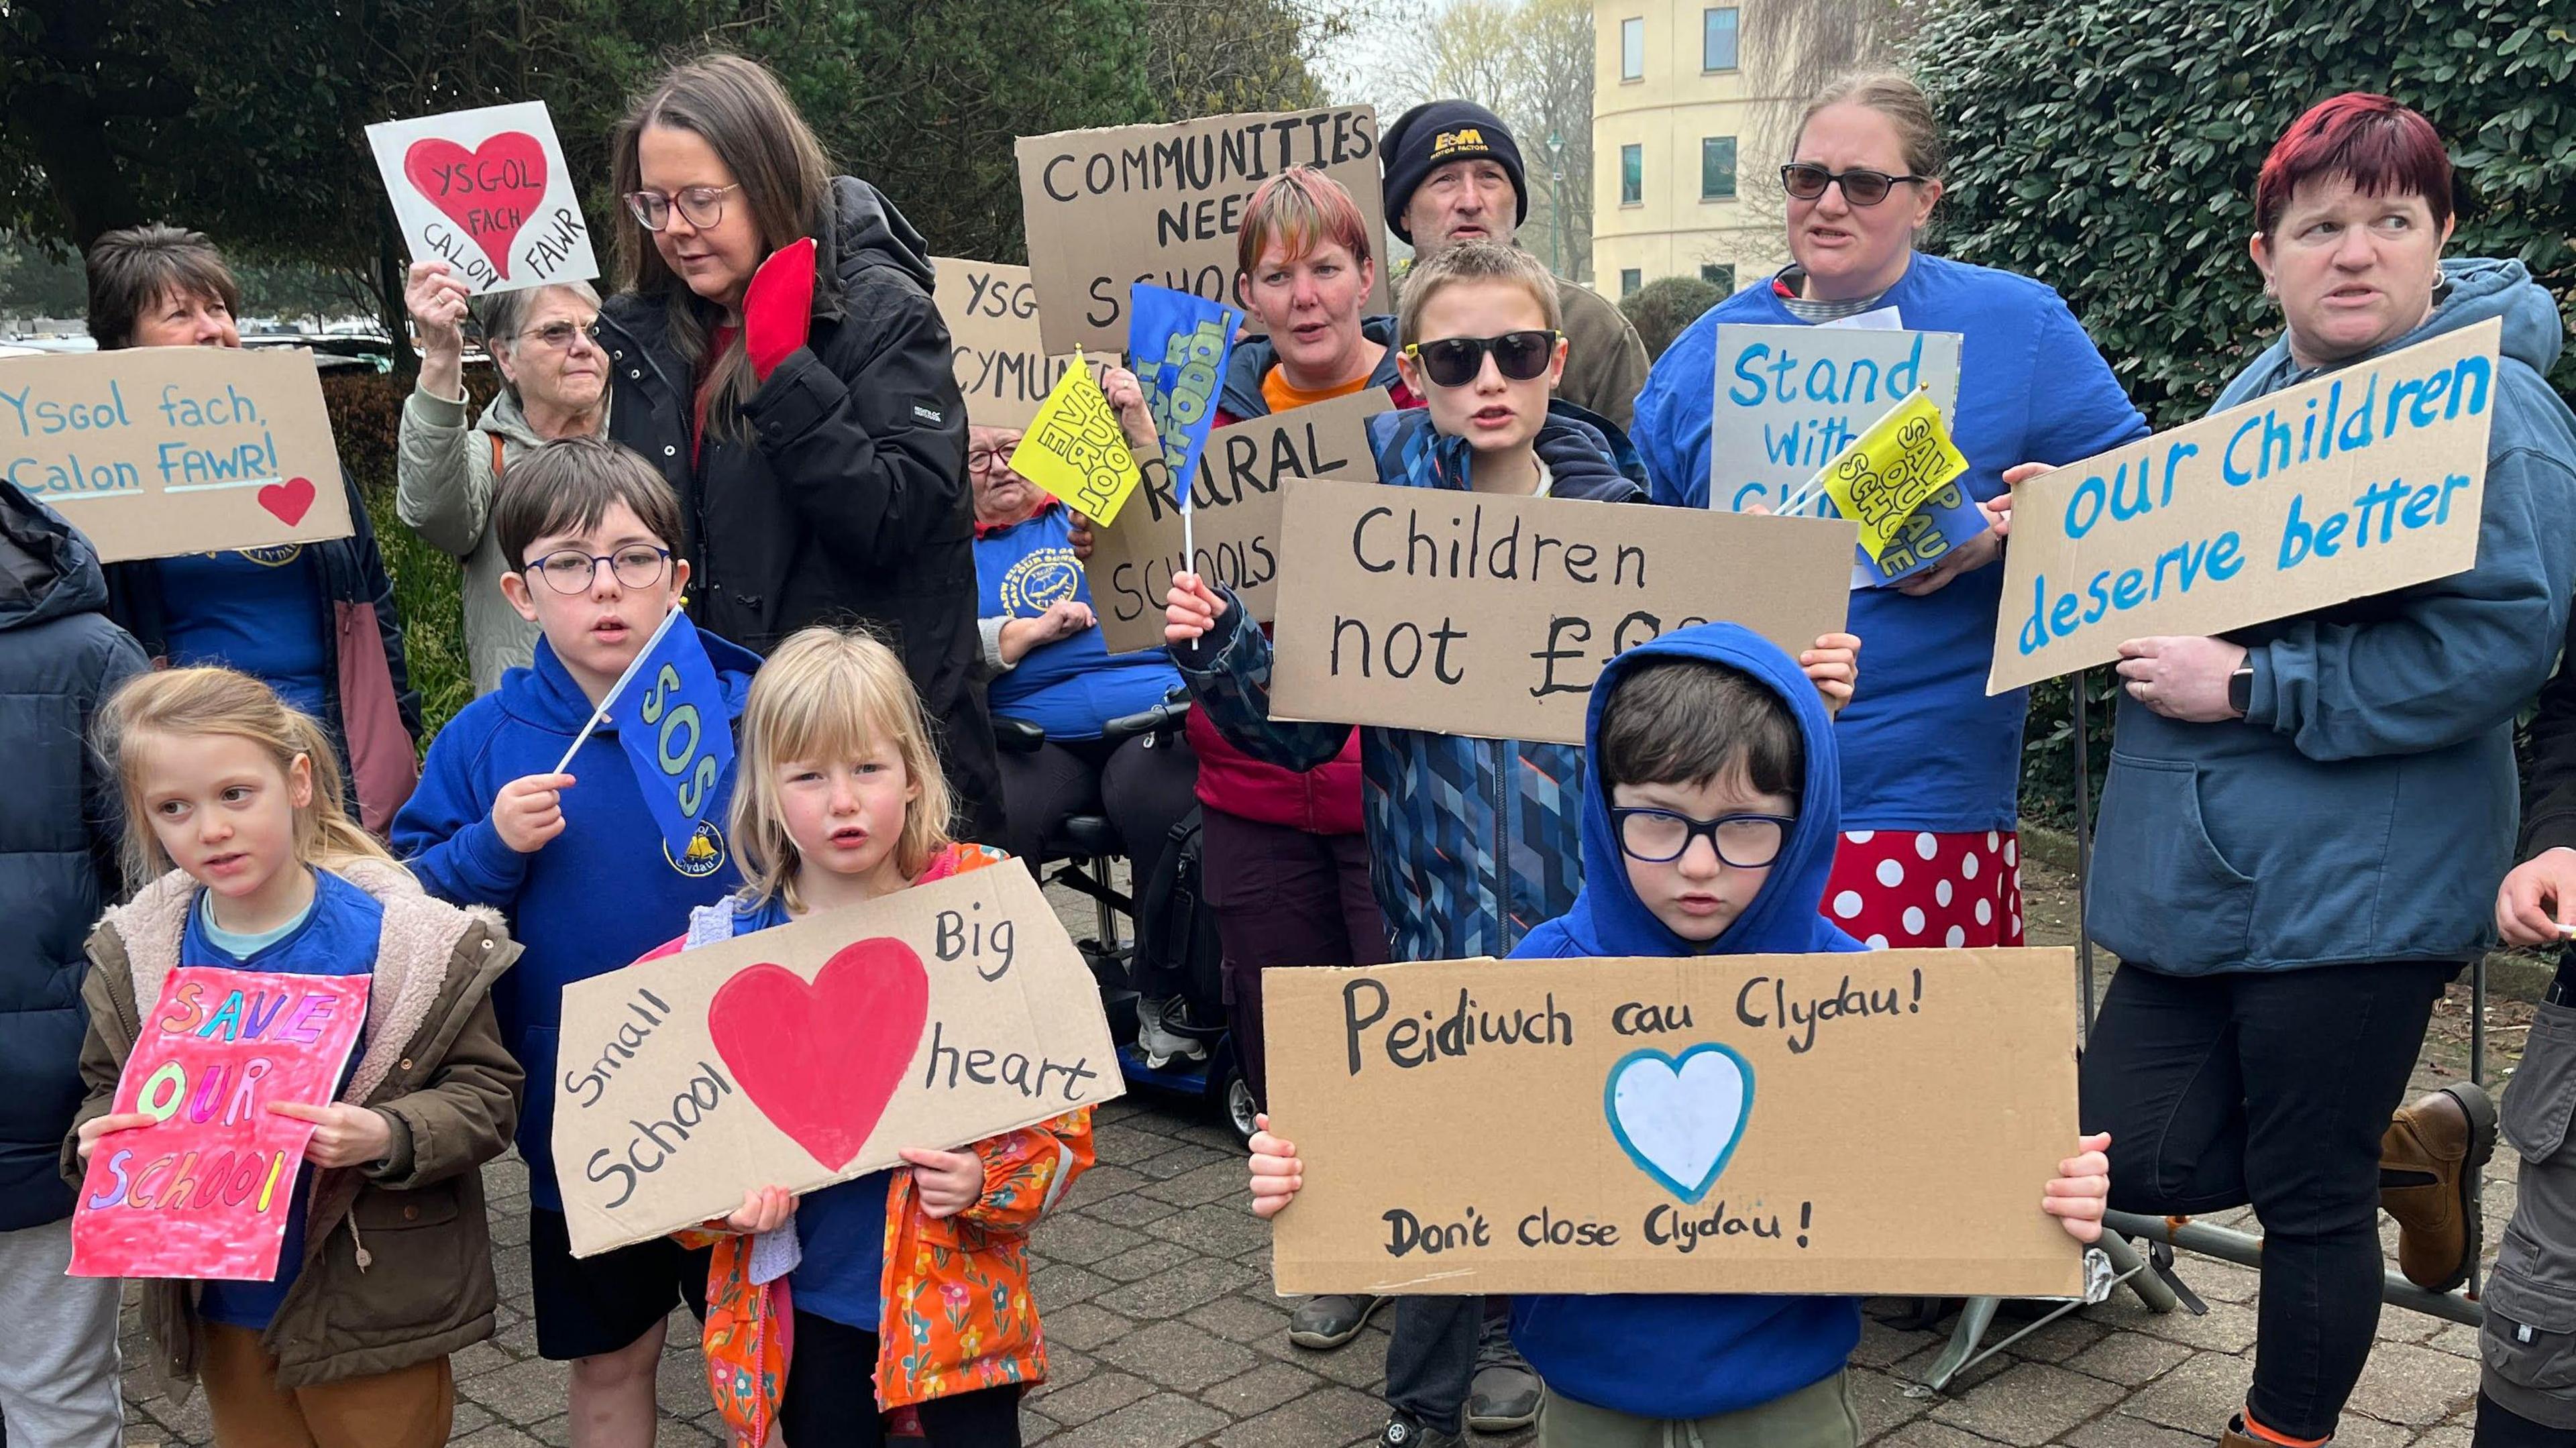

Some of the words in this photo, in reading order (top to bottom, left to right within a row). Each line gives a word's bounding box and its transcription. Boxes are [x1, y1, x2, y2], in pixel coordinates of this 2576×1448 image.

[1043, 111, 1373, 201] COMMUNITIES
[1430, 146, 1455, 160] MOTOR
[1434, 129, 1483, 152] E&M
[433, 160, 542, 196] YSGOL
[469, 208, 522, 235] FACH
[525, 208, 585, 279] FAWR
[1157, 192, 1258, 247] NEE
[424, 223, 499, 291] CALON
[1729, 332, 1924, 407] Stand
[1897, 416, 1954, 490] SAV
[2222, 355, 2491, 487] Children
[8, 454, 140, 495] Calon
[156, 430, 277, 484] FAWR!
[1140, 422, 1348, 522] RURAL
[1839, 453, 1904, 540] SCHO
[1880, 459, 1928, 512] OU
[1353, 504, 1646, 589] Children
[2019, 530, 2245, 657] deserve
[2278, 474, 2471, 571] better
[1331, 614, 1468, 684] not
[641, 663, 717, 819] SOS
[935, 901, 1014, 982] Big
[160, 983, 337, 1044] SAVE
[565, 988, 671, 1109] Small
[1342, 978, 1573, 1076] Peidiwch
[1611, 1001, 1694, 1034] cau
[1735, 968, 1921, 1054] Clydau!
[136, 1058, 274, 1127] OUR
[926, 1022, 1097, 1101] heart
[586, 1062, 732, 1209] School
[1383, 1207, 1490, 1257] Don't
